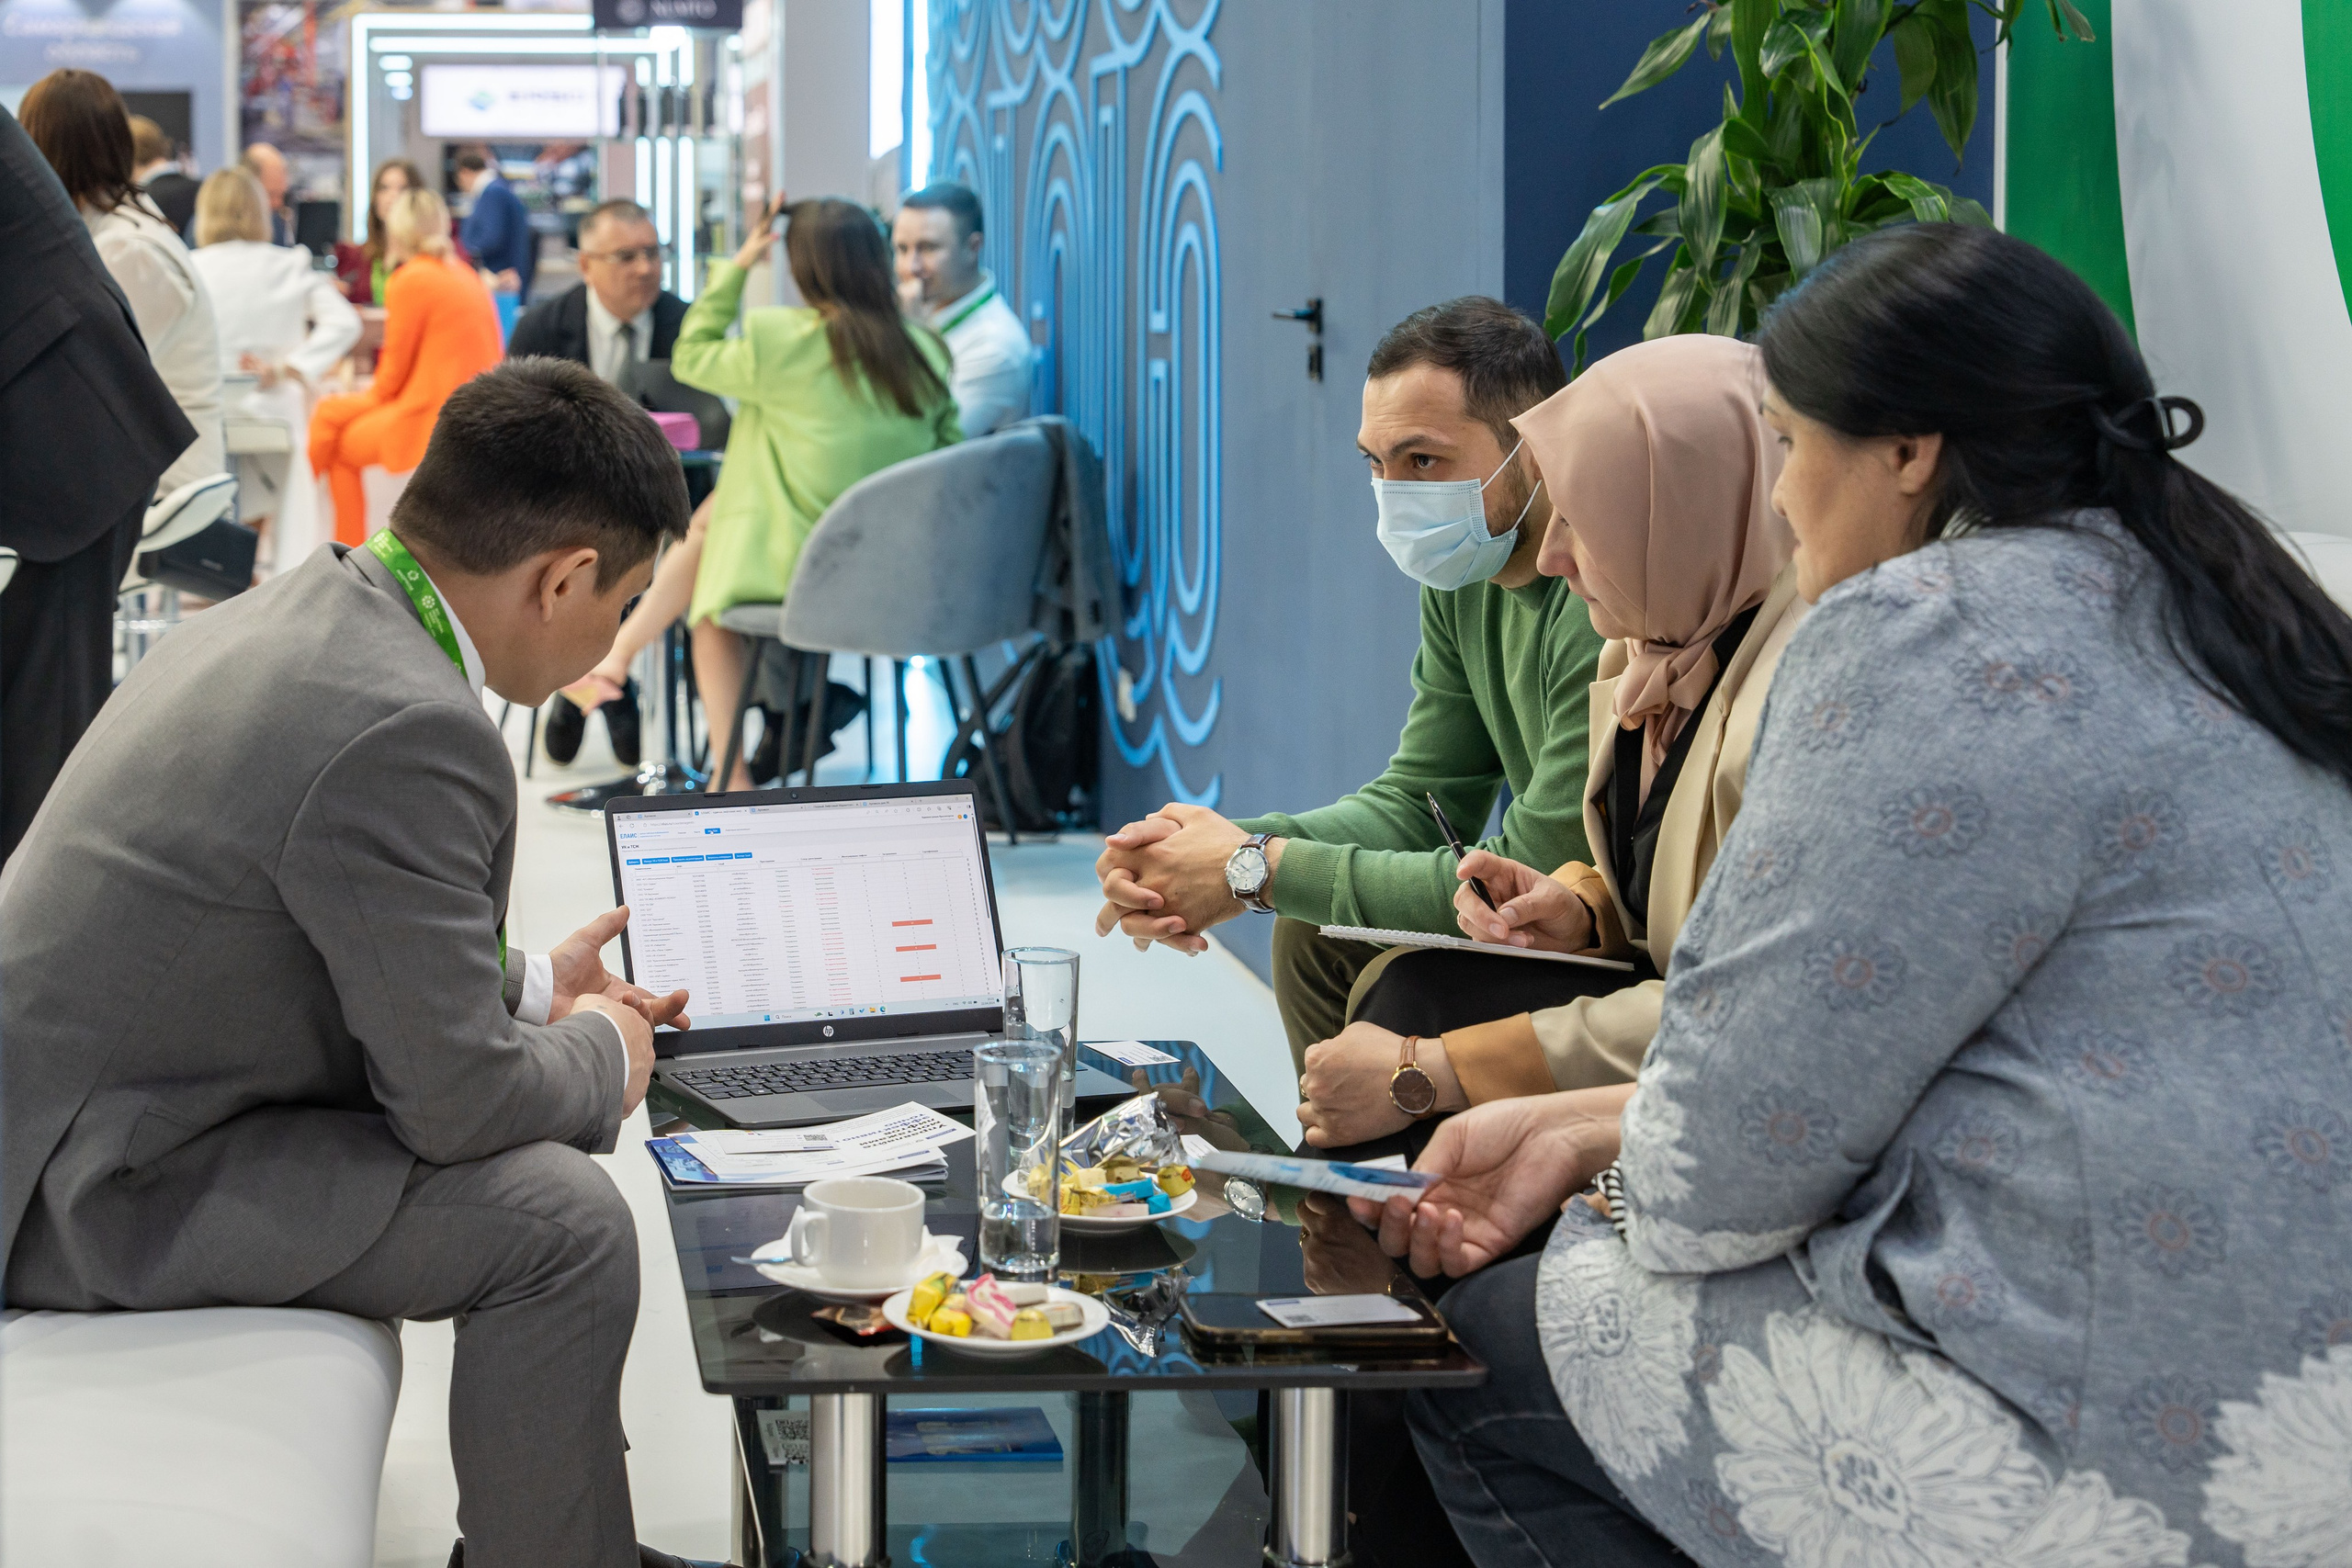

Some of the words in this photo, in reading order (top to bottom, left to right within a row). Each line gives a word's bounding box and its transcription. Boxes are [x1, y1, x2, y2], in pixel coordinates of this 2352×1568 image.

[824, 1025, 833, 1037] hp
[842, 1116, 930, 1142] эффективно
[883, 1118, 935, 1135] лифтов
[884, 1113, 925, 1127] точно
[859, 1121, 941, 1145] монтажами
[862, 1123, 947, 1149] Управляйте
